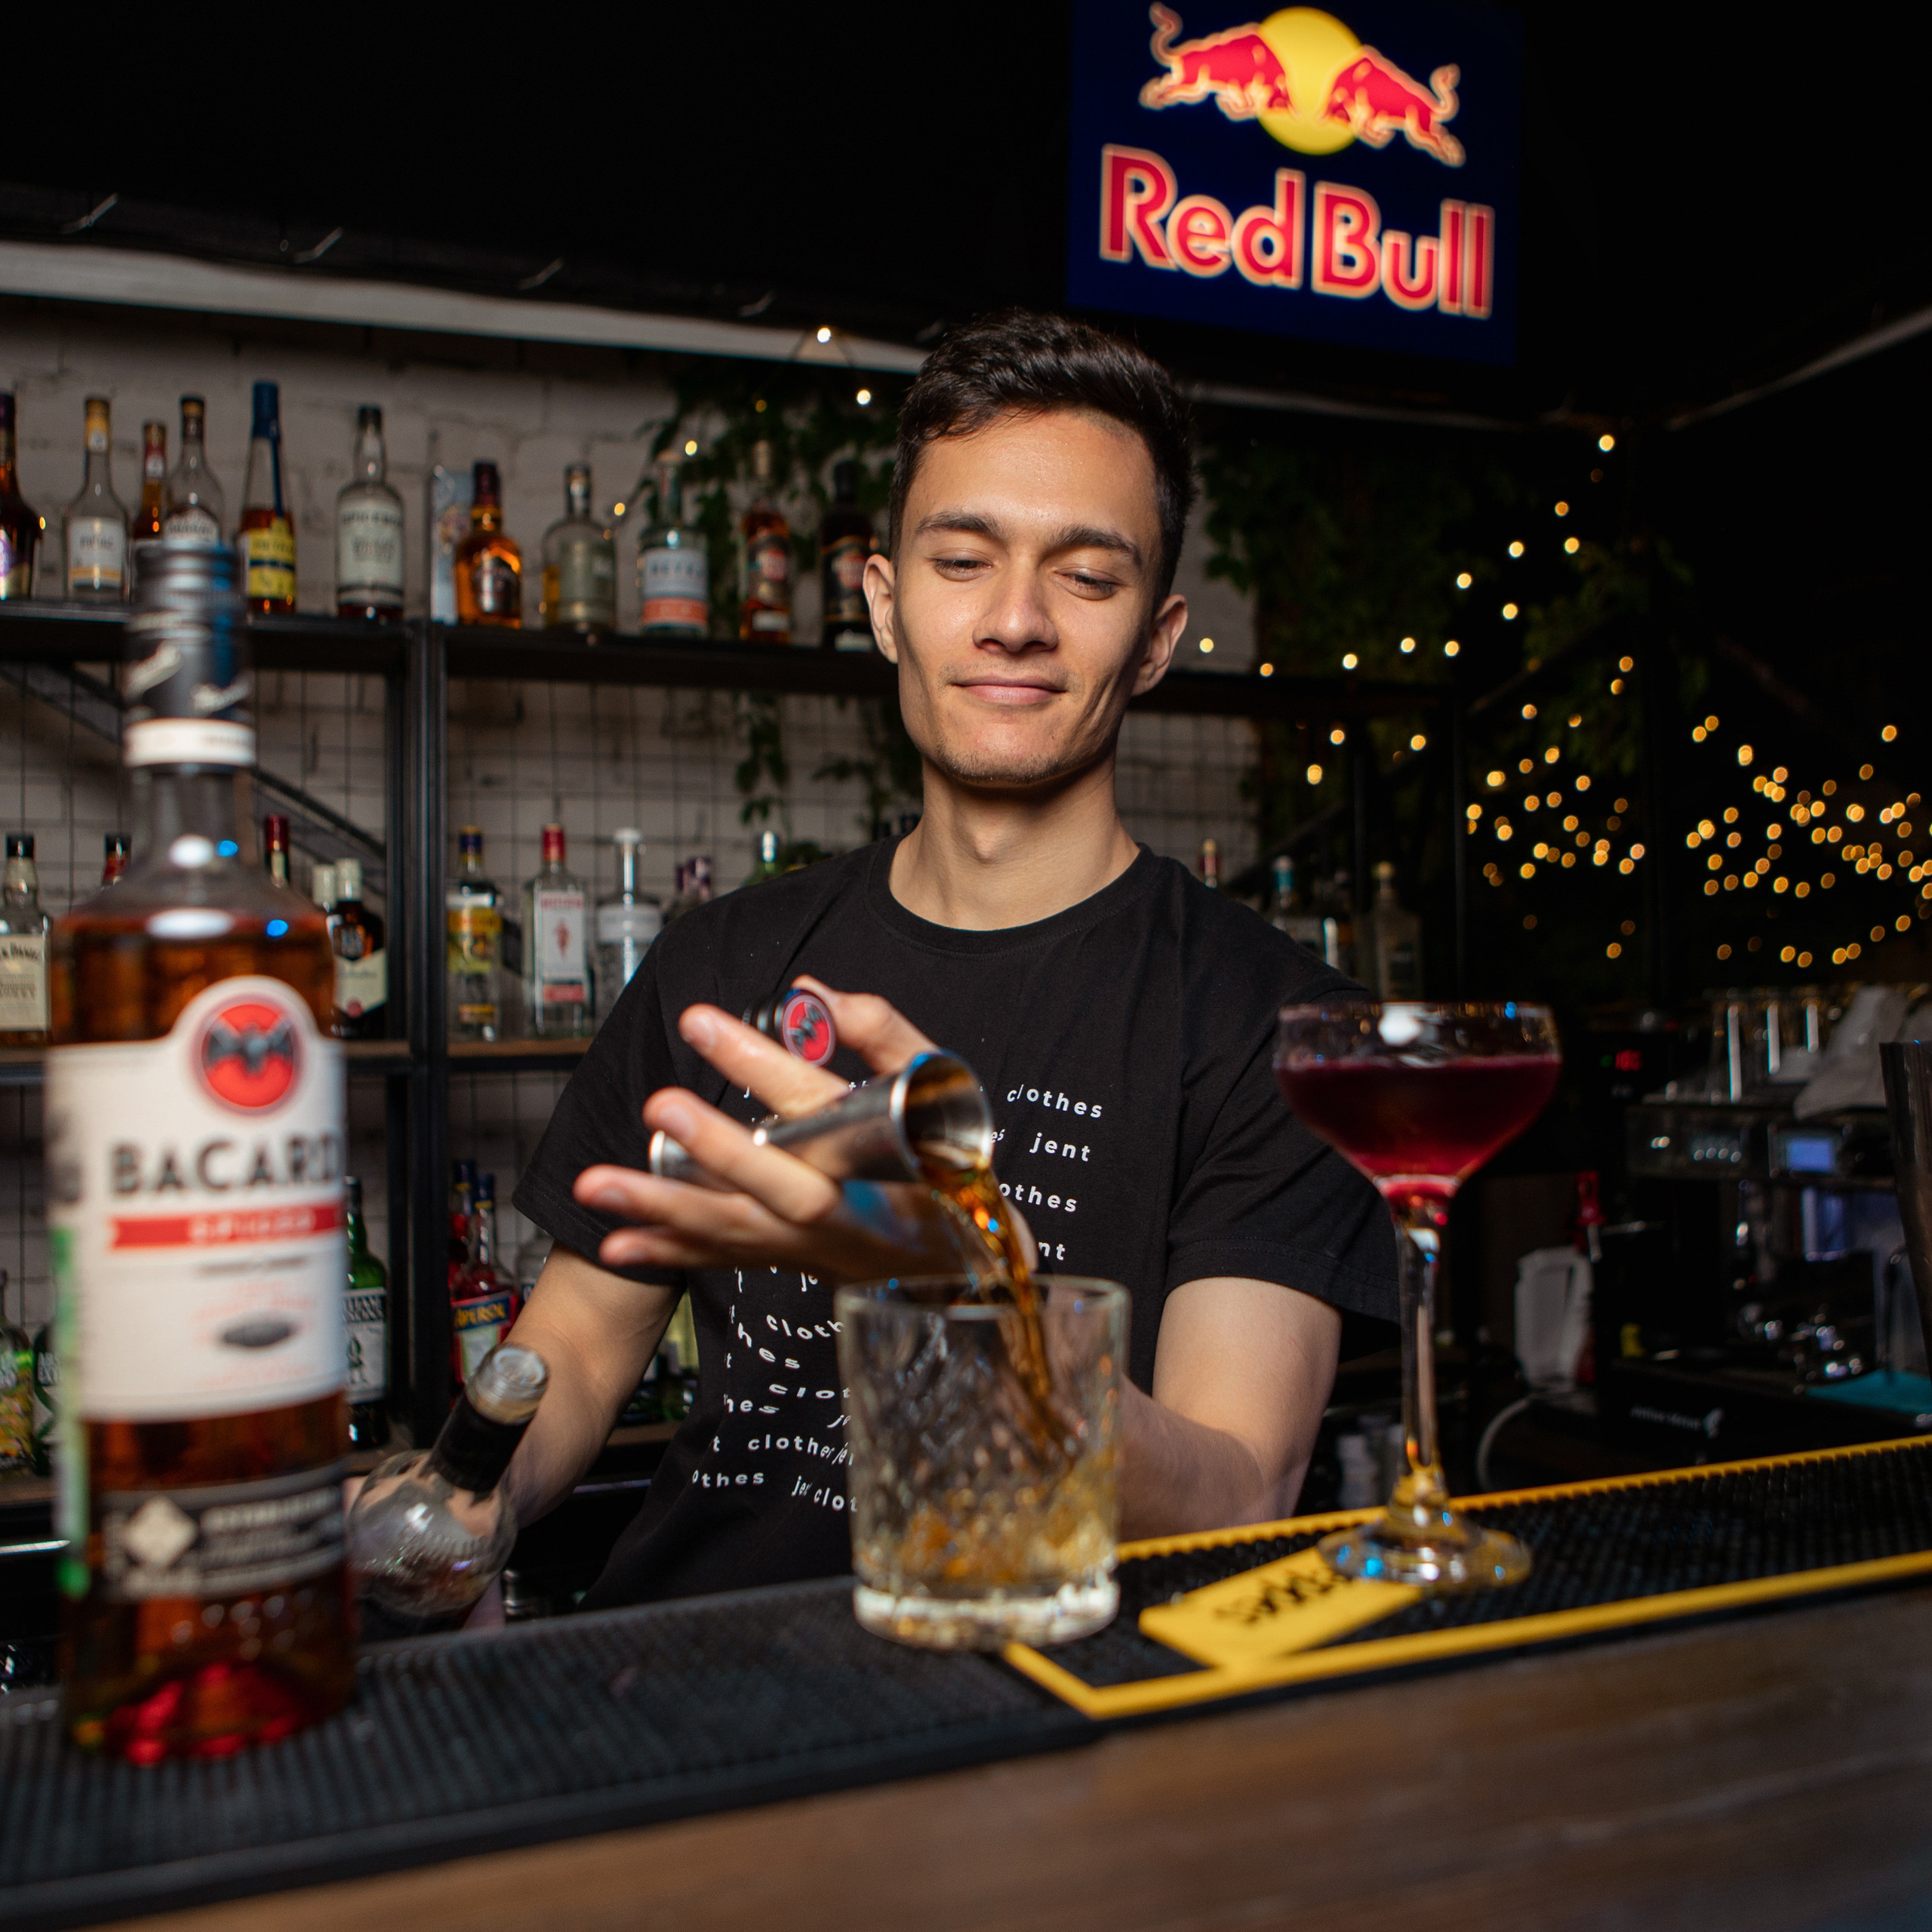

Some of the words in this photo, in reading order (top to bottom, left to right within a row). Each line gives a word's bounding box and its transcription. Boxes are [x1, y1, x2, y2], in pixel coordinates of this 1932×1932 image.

[1100, 143, 1306, 290] Red
[1311, 180, 1495, 319] Bull
[1006, 1084, 1103, 1118] clothes
[1029, 1132, 1091, 1162] jent
[998, 1183, 1078, 1213] othes
[1038, 1240, 1066, 1261] nt
[766, 1314, 844, 1340] cloth
[768, 1383, 852, 1399] clot
[813, 1487, 858, 1512] clot
